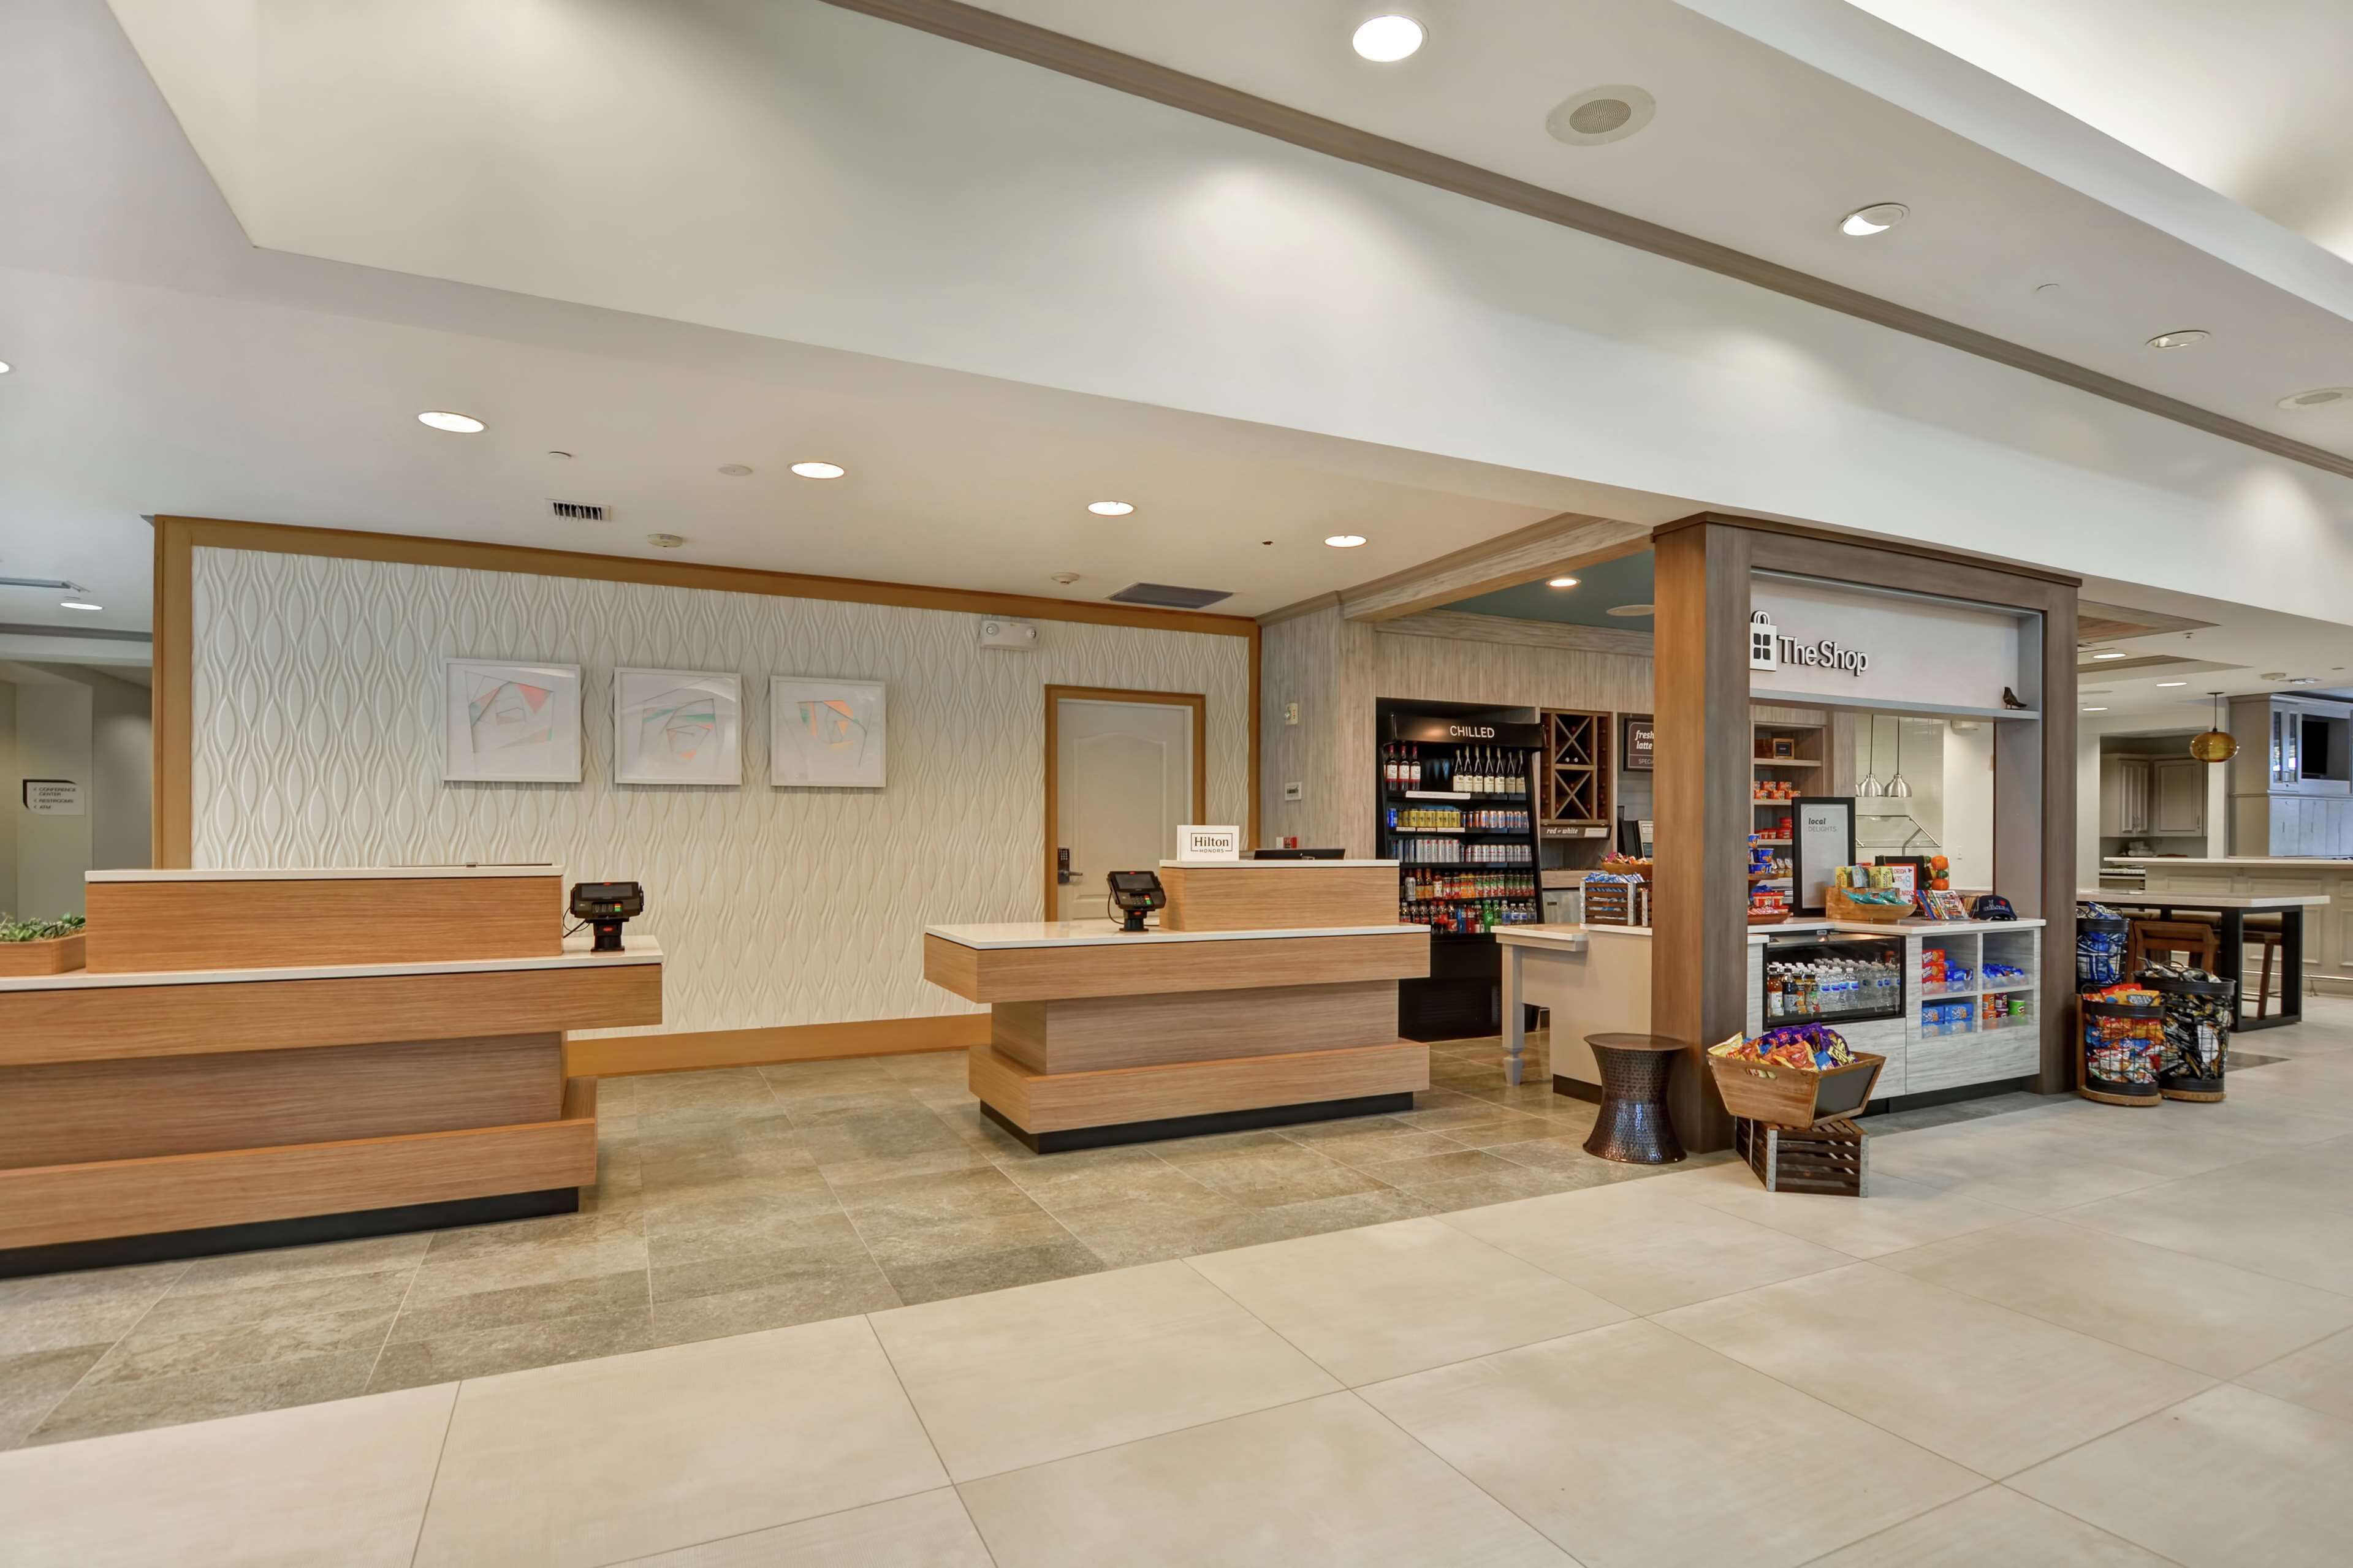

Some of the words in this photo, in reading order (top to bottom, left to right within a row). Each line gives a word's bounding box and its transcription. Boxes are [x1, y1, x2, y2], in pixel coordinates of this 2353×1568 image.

[1777, 635, 1817, 666] The
[1818, 640, 1869, 677] Shop
[1450, 725, 1495, 738] CHILLED
[1635, 730, 1654, 741] fresh
[1636, 740, 1653, 750] latte
[1195, 836, 1229, 847] Hilton
